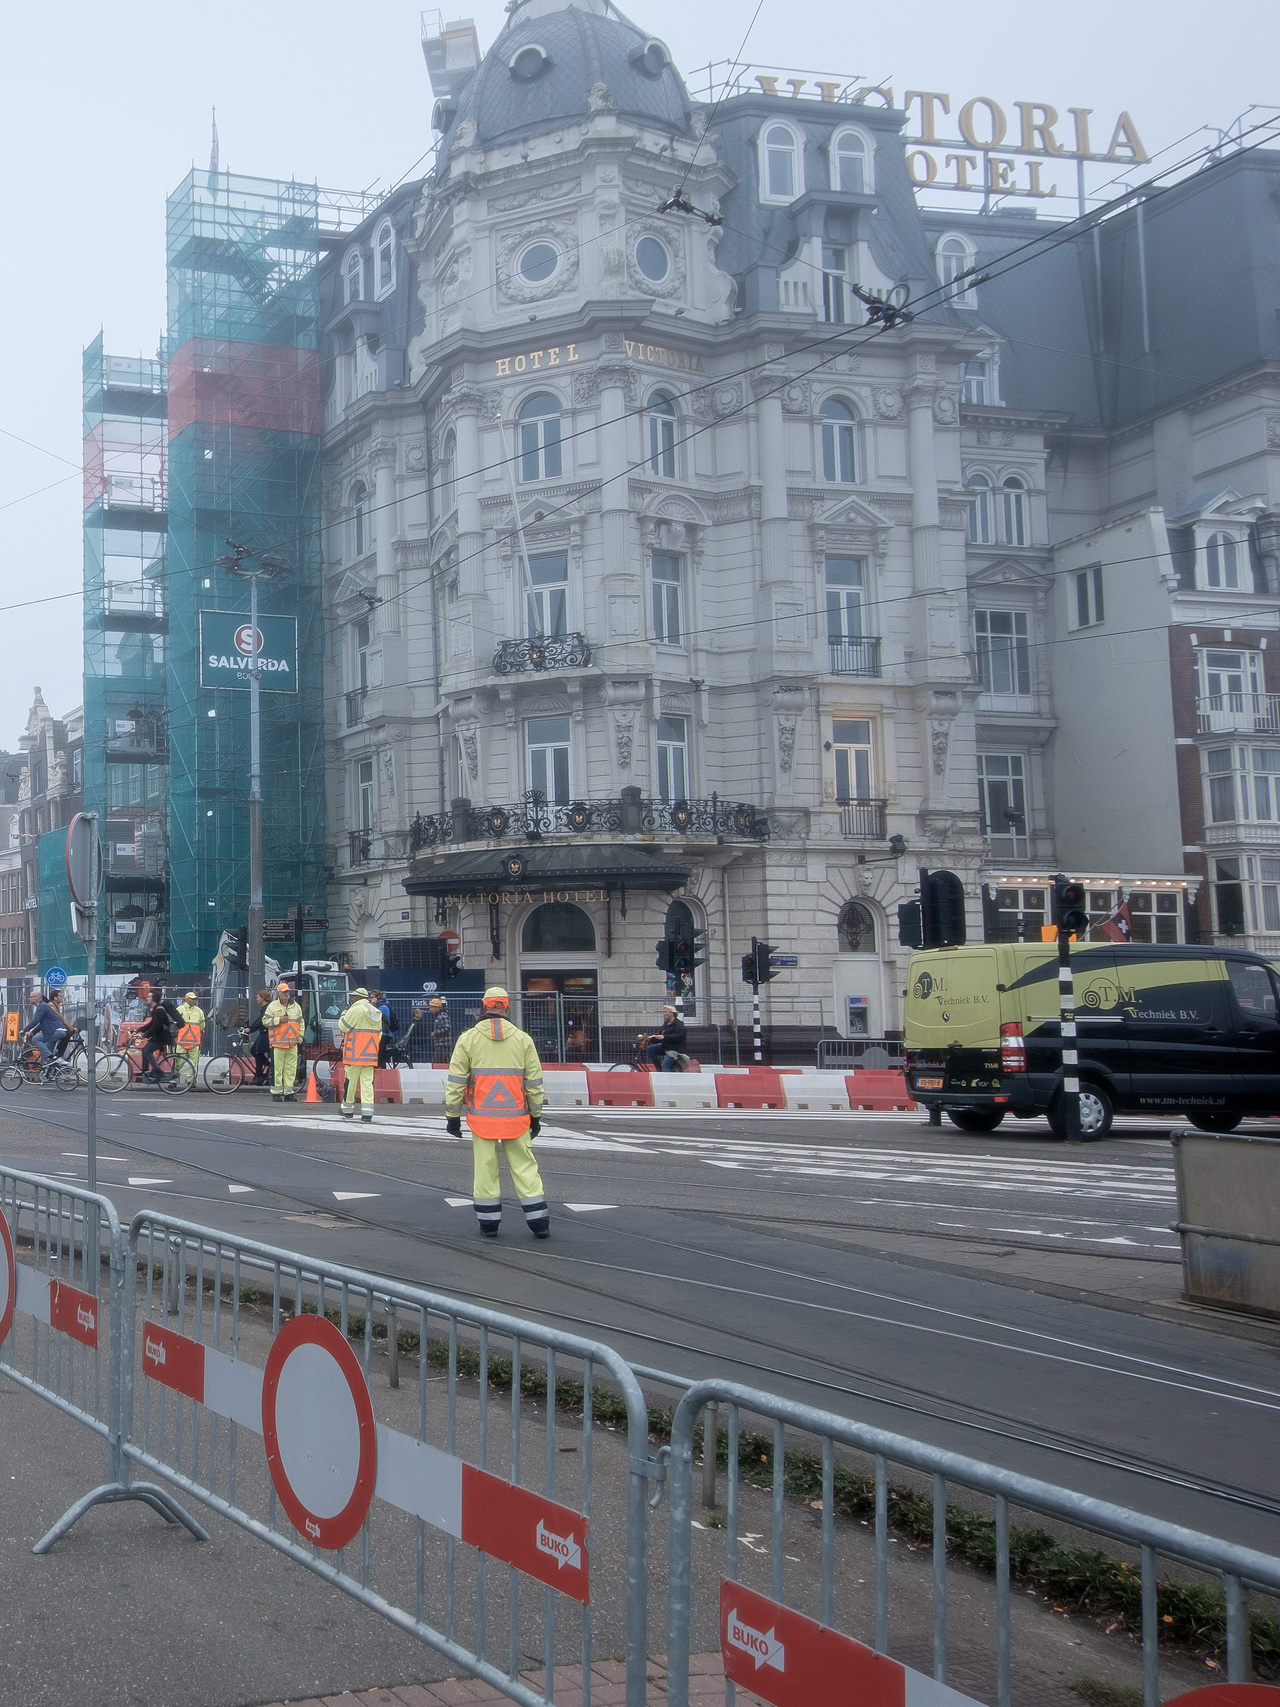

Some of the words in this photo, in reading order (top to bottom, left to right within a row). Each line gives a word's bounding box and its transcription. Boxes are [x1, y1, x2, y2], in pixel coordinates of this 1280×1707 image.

[906, 150, 1057, 198] OTEL
[495, 343, 579, 377] HOTEL
[624, 339, 705, 374] VICTORIA
[446, 891, 534, 905] VICTORIA
[543, 889, 610, 904] HOTEL
[1123, 1006, 1177, 1020] Techniek
[1179, 1010, 1199, 1020] B.V.
[1139, 1096, 1226, 1105] www.tm-techniek.nl
[148, 1344, 160, 1358] BUKO
[540, 1533, 569, 1557] BUKO
[732, 1624, 769, 1656] BUKO
